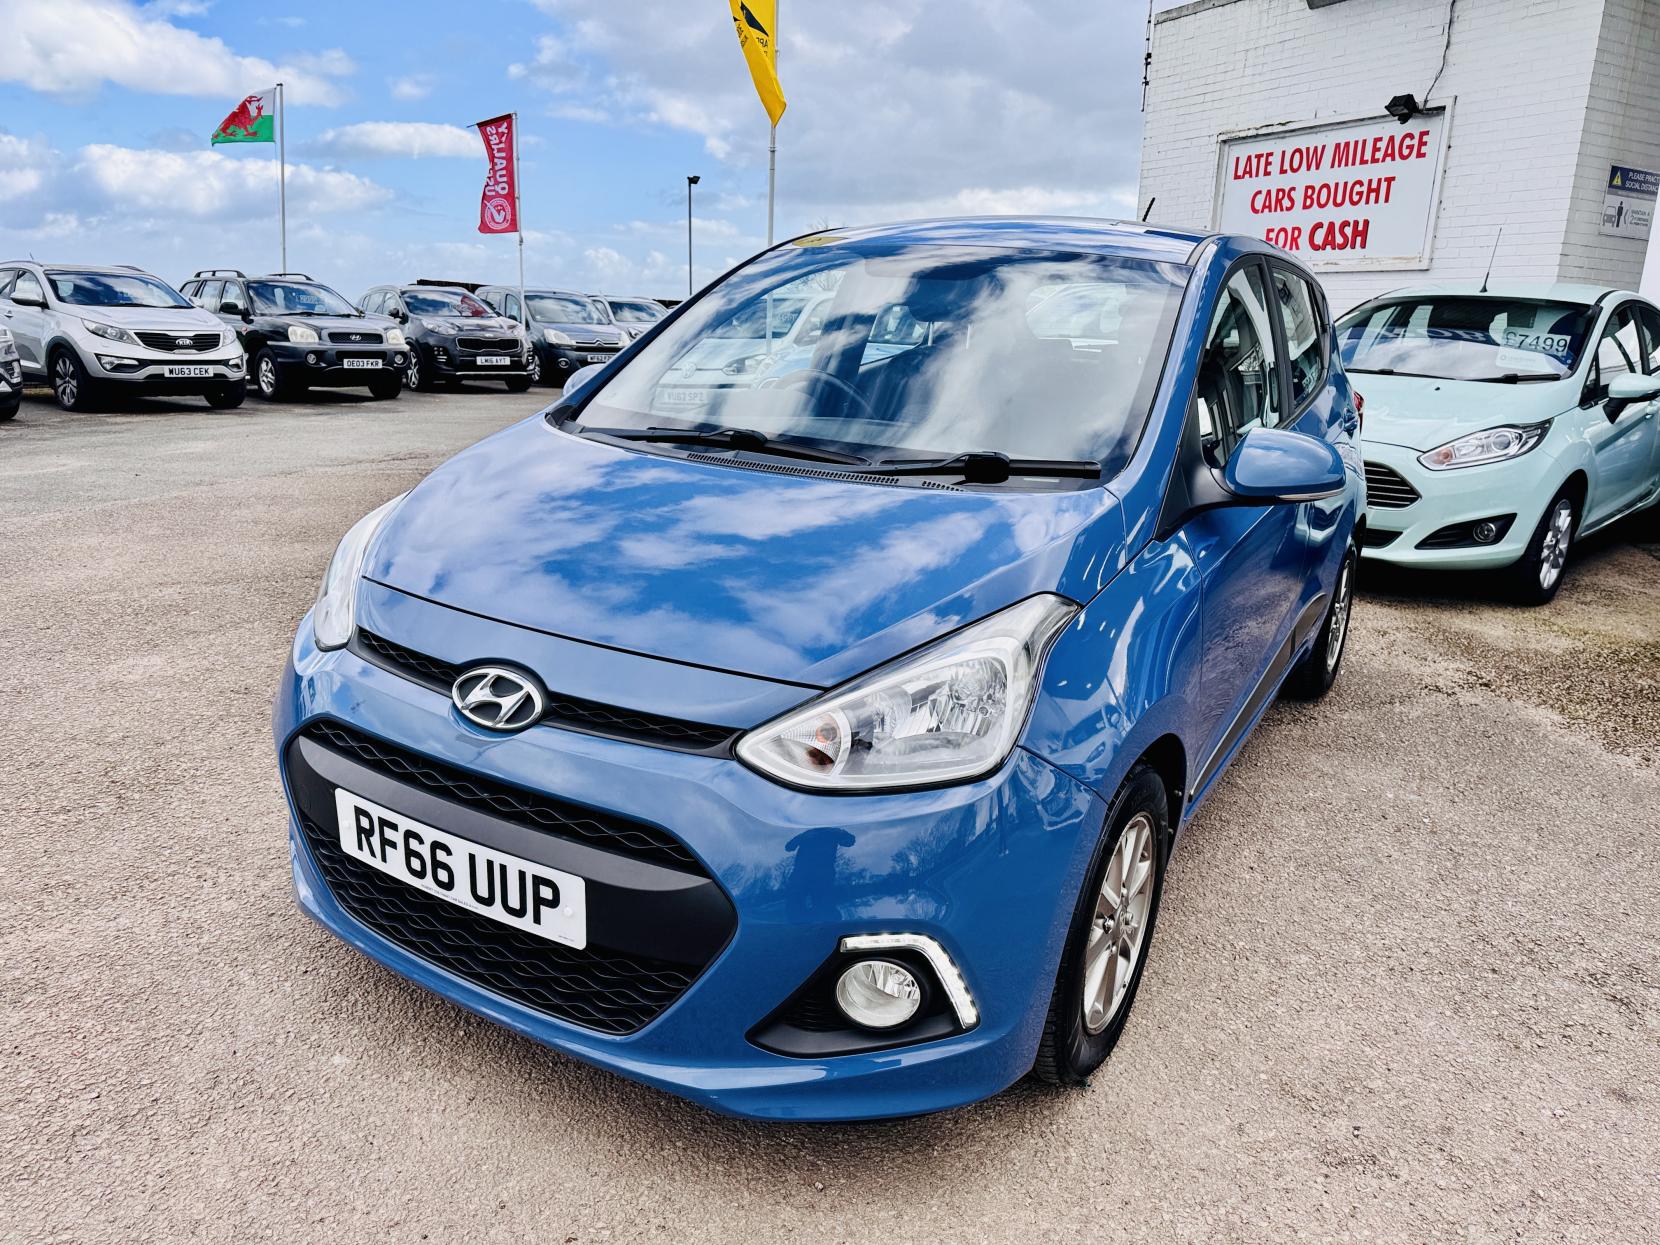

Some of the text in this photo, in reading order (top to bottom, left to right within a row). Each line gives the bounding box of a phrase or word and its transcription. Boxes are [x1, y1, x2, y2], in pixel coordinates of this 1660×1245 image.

[1233, 130, 1430, 180] LATE LOW MILEAGE
[1625, 180, 1640, 190] SOCIAL
[1628, 172, 1645, 181] PLEASE
[1250, 176, 1396, 214] CARS BOUGHT
[1265, 219, 1370, 252] FOR CASH
[1504, 331, 1568, 353] £7499
[168, 367, 210, 375] WU63 CEK
[353, 805, 561, 926] RF66 UUP
